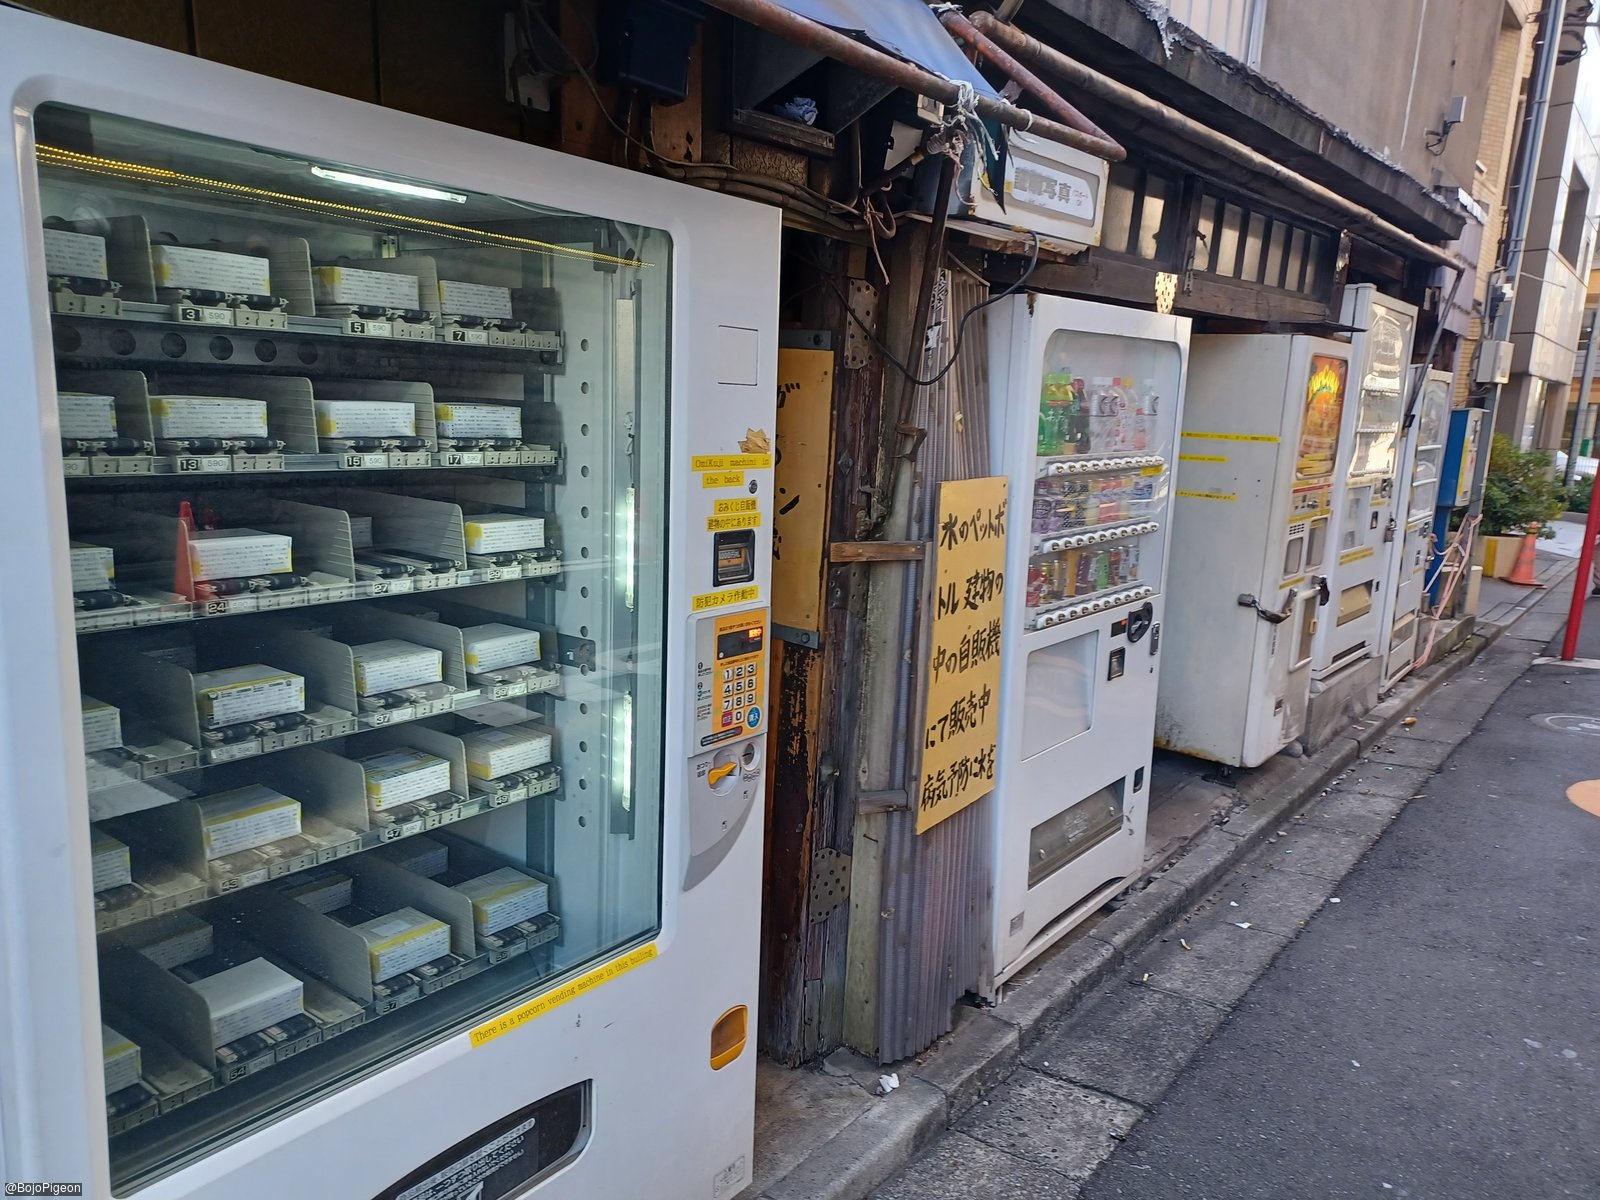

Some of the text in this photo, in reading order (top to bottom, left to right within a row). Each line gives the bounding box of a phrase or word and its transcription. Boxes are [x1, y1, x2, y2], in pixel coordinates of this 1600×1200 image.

[186, 310, 225, 320] 3 590
[354, 322, 386, 332] 5 590
[454, 331, 463, 340] 7
[347, 456, 360, 466] 15
[449, 454, 460, 464] 17
[762, 458, 770, 466] in
[182, 460, 198, 470] 13
[706, 475, 741, 485] the back
[718, 499, 757, 513] おみくじ自販機
[707, 516, 758, 530] 建物の中にあります
[940, 498, 1007, 551] 水のペットボ
[488, 570, 500, 579] 29
[374, 583, 388, 593] 27
[695, 588, 755, 609] 防犯カメラ作動中
[209, 603, 226, 614] 24
[932, 616, 1001, 684] 中の自販機
[736, 667, 743, 676] 2
[747, 664, 755, 674] 3
[724, 679, 754, 694] 4 5 6
[724, 694, 753, 709] 7 8 9
[376, 713, 389, 724] 37
[736, 711, 742, 720] 0
[925, 684, 991, 749] にて販売中
[496, 795, 508, 805] 49
[387, 830, 400, 841] 47
[474, 1025, 497, 1042] There
[499, 1019, 508, 1031] is
[509, 1017, 515, 1026] a
[517, 1001, 546, 1024] popcorn
[549, 985, 576, 1006] vending
[577, 973, 604, 991] machine
[606, 967, 614, 978] in
[615, 960, 629, 974] this
[230, 1069, 246, 1081] 54
